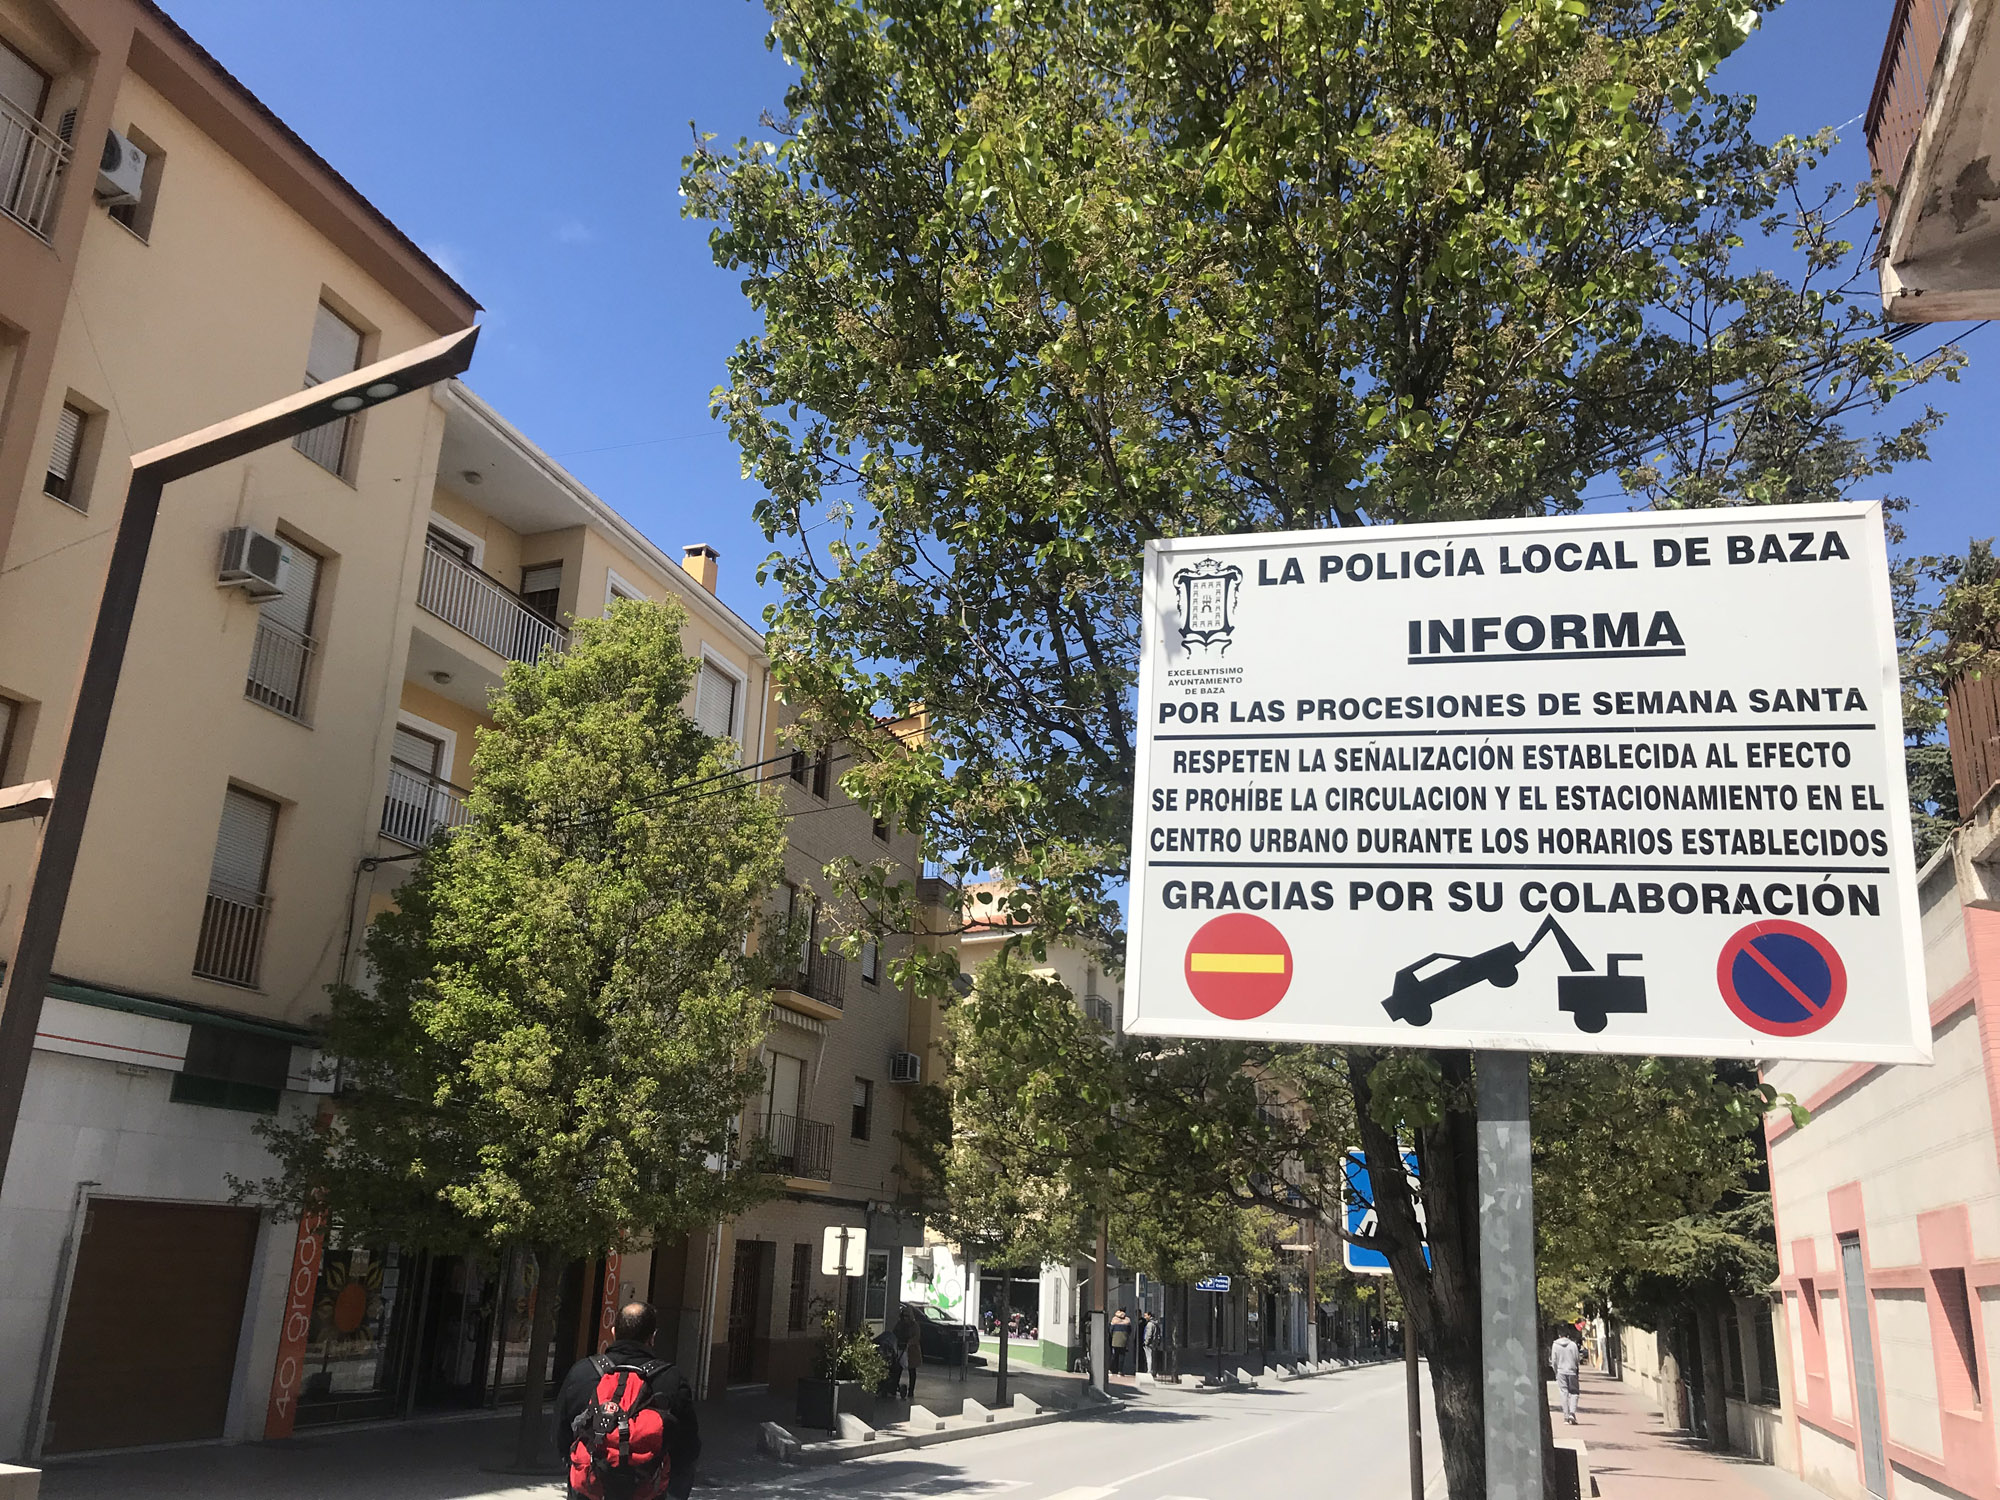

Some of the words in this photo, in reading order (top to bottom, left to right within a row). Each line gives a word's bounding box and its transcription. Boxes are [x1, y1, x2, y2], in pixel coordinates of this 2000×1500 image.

[1258, 557, 1305, 586] LA
[1319, 540, 1485, 583] POLICÍA
[1499, 540, 1638, 575] LOCAL
[1653, 536, 1711, 568] DE
[1726, 530, 1850, 565] BAZA
[1408, 610, 1685, 654] INFORMA
[1167, 666, 1244, 677] EXCELENTISIMO
[1168, 677, 1243, 687] AYUNTAMIENTO
[1159, 701, 1219, 724] POR
[1230, 699, 1285, 723] LAS
[1296, 693, 1526, 722] PROCESIONES
[1538, 692, 1581, 716] DE
[1592, 689, 1738, 716] SEMANA
[1748, 687, 1868, 714] SANTA
[1173, 749, 1290, 774] RESPETEN
[1298, 748, 1327, 773] LA
[1334, 737, 1514, 773] SEÑALIZACIÓN
[1522, 743, 1698, 770] ESTABLECIDA
[1705, 742, 1738, 769] AL
[1746, 741, 1851, 769] EFECTO
[1151, 788, 1178, 812] SE
[1185, 780, 1283, 812] PROHÍBE
[1291, 788, 1318, 812] LA
[1325, 785, 1487, 812] CIRCULACION
[1494, 786, 1511, 811] Y
[1519, 785, 1548, 811] EL
[1555, 784, 1798, 811] ESTACIONAMIENTO
[1806, 784, 1843, 811] EN
[1851, 784, 1885, 811] EL
[1150, 827, 1242, 853] CENTRO
[1250, 827, 1349, 854] URBANO
[1357, 828, 1473, 854] DURANTE
[1481, 827, 1529, 855] LOS
[1537, 827, 1673, 856] HORARIOS
[1681, 828, 1888, 857] ESTABLECIDOS
[1162, 880, 1334, 911] GRACIAS
[1349, 880, 1434, 912] POR
[1448, 880, 1504, 913] SU
[1519, 873, 1881, 917] COLABORACIÓN
